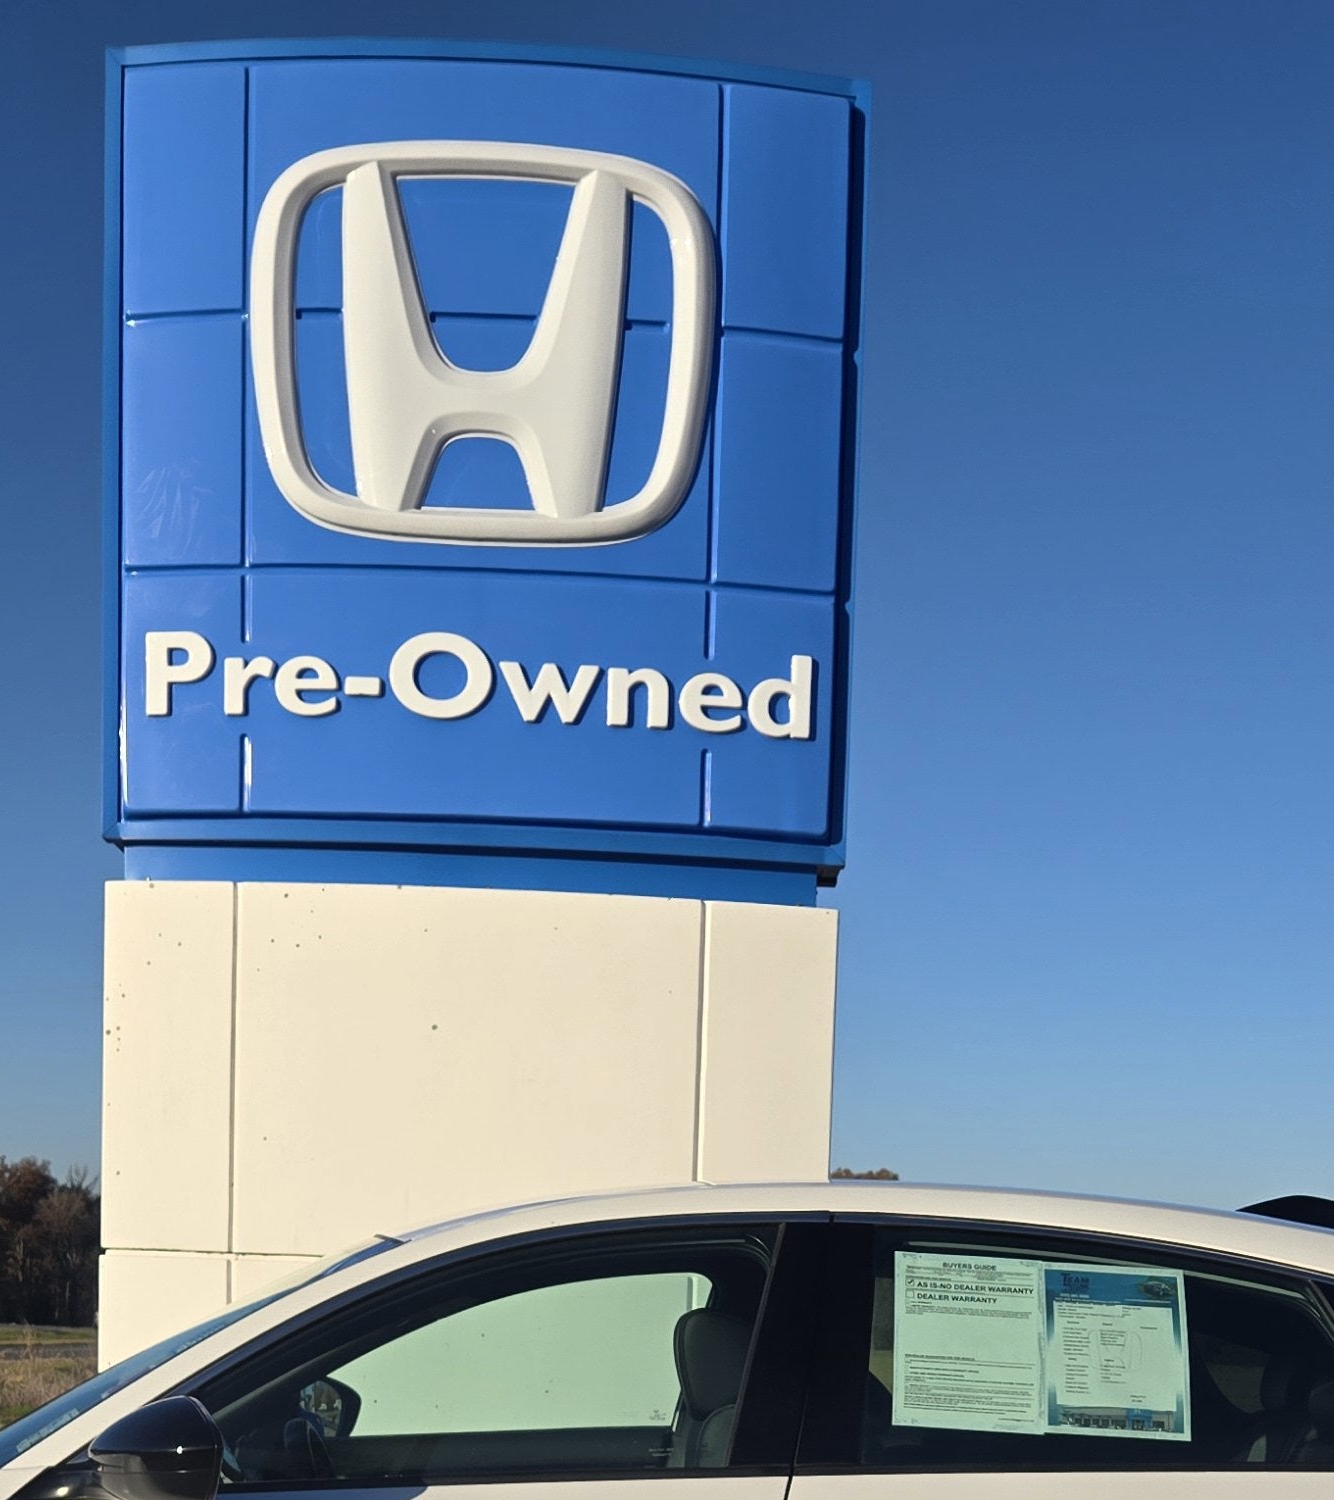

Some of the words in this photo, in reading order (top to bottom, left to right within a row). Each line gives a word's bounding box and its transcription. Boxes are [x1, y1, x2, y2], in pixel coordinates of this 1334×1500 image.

[143, 631, 814, 739] Pre-Owned
[942, 1262, 973, 1270] BUYERS
[974, 1263, 997, 1271] GUIDE
[954, 1284, 987, 1292] DEALER
[988, 1286, 1034, 1295] WARRANTY
[917, 1293, 949, 1301] DEALER
[951, 1295, 998, 1304] WARRANTY
